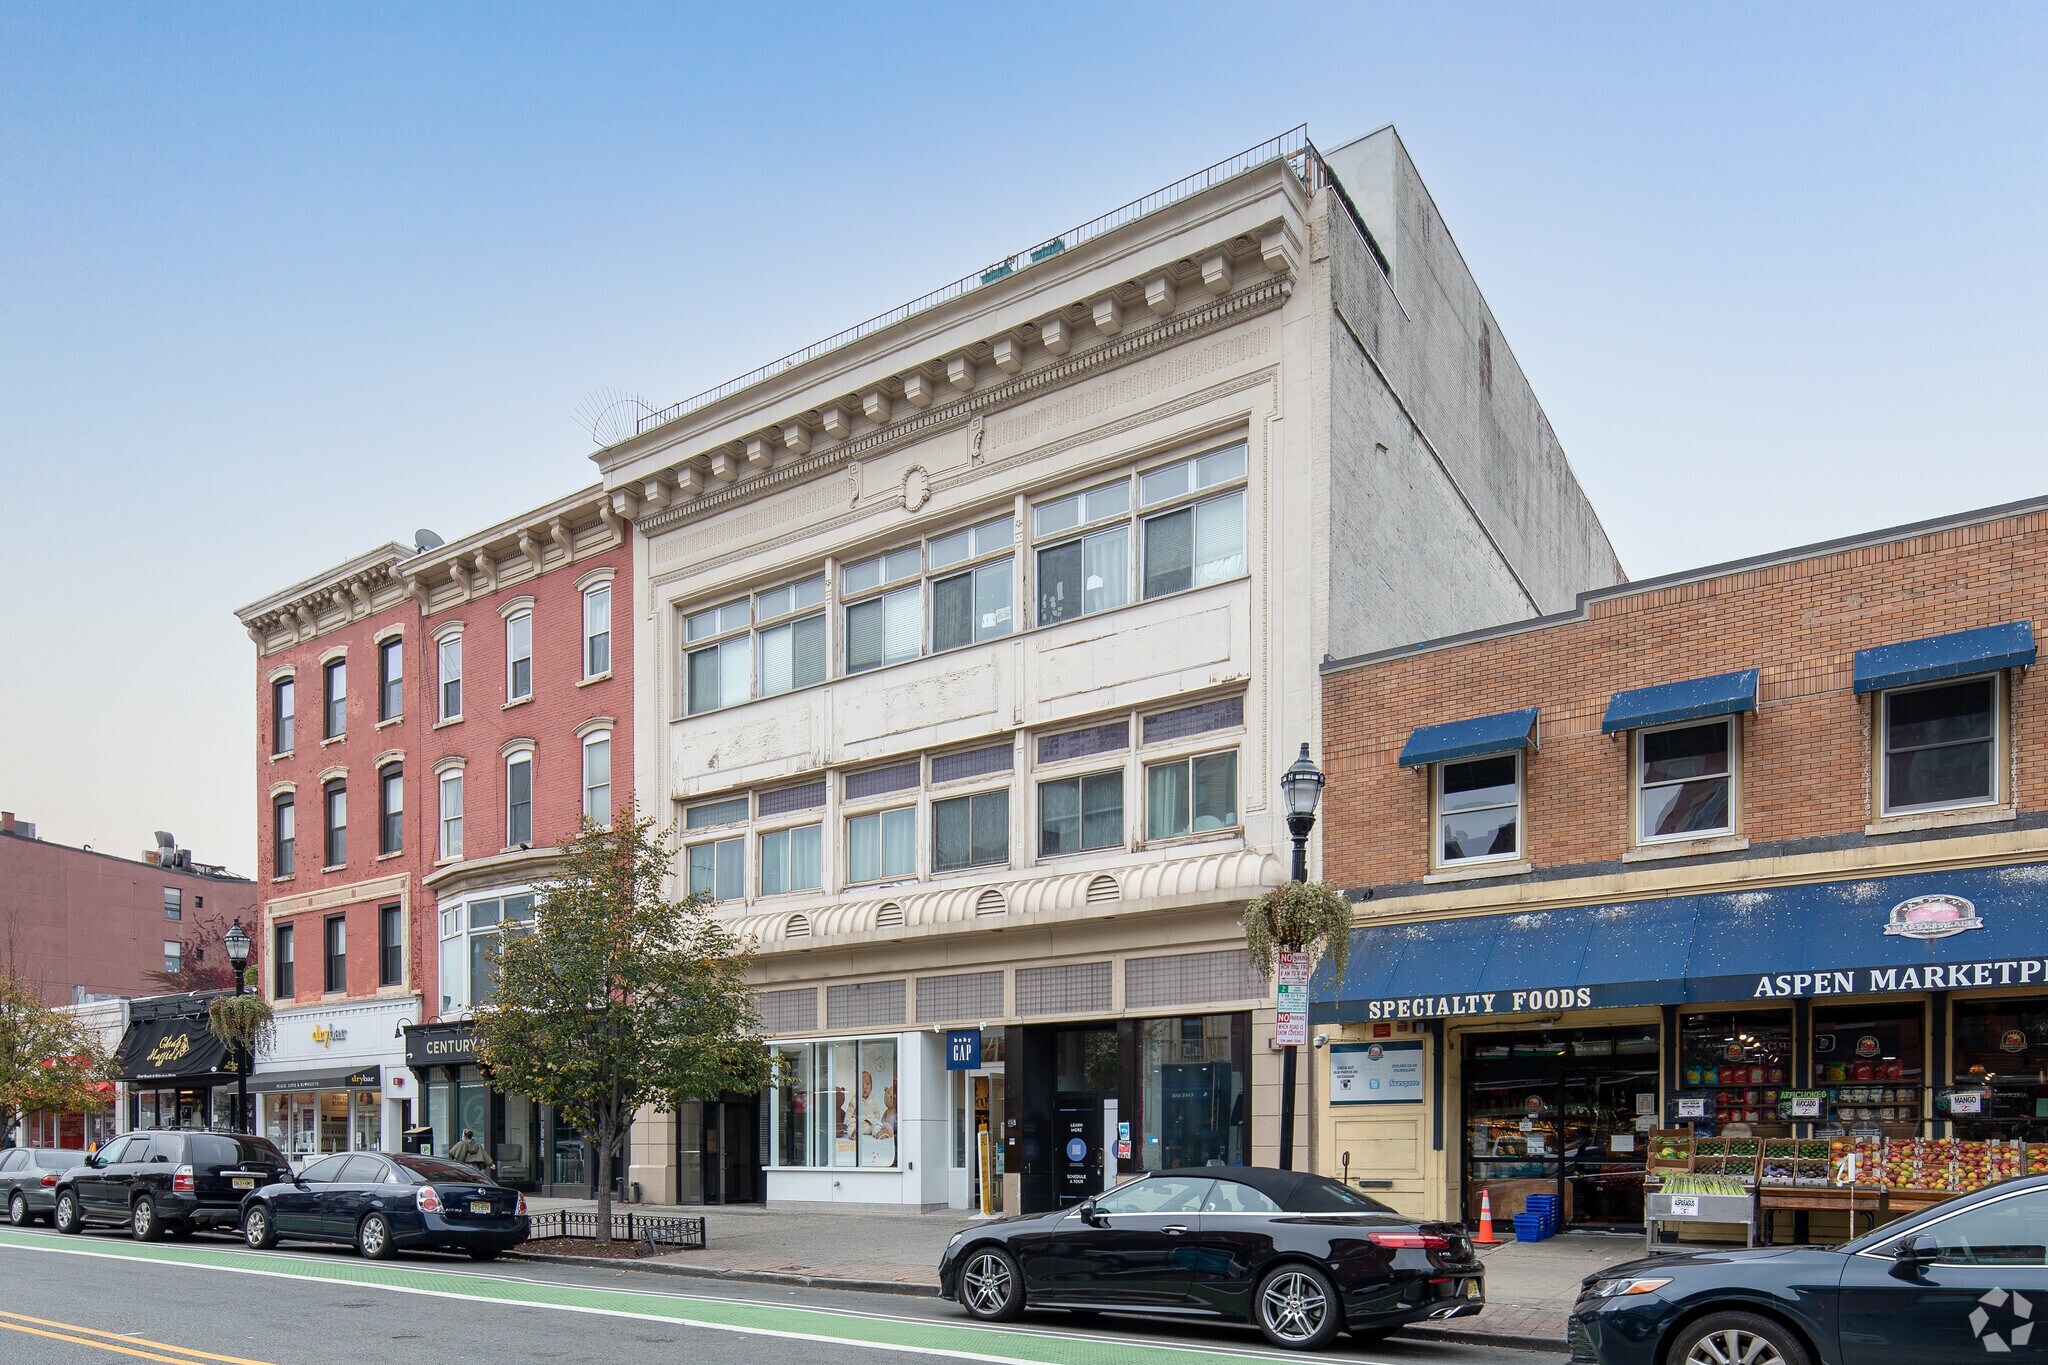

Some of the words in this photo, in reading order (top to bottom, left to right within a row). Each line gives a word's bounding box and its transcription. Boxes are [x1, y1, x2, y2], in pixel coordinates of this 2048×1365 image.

[1281, 953, 1292, 962] NO
[1753, 971, 1855, 998] ASPEN
[1368, 994, 1496, 1019] SPECIALTY
[1512, 987, 1591, 1011] FOODS
[1278, 1014, 1290, 1022] NO
[312, 1023, 348, 1048] drybar
[426, 1039, 477, 1054] CENTURY
[953, 1044, 972, 1061] GAP
[351, 1074, 374, 1084] drybar
[1388, 1078, 1420, 1088] foursquare
